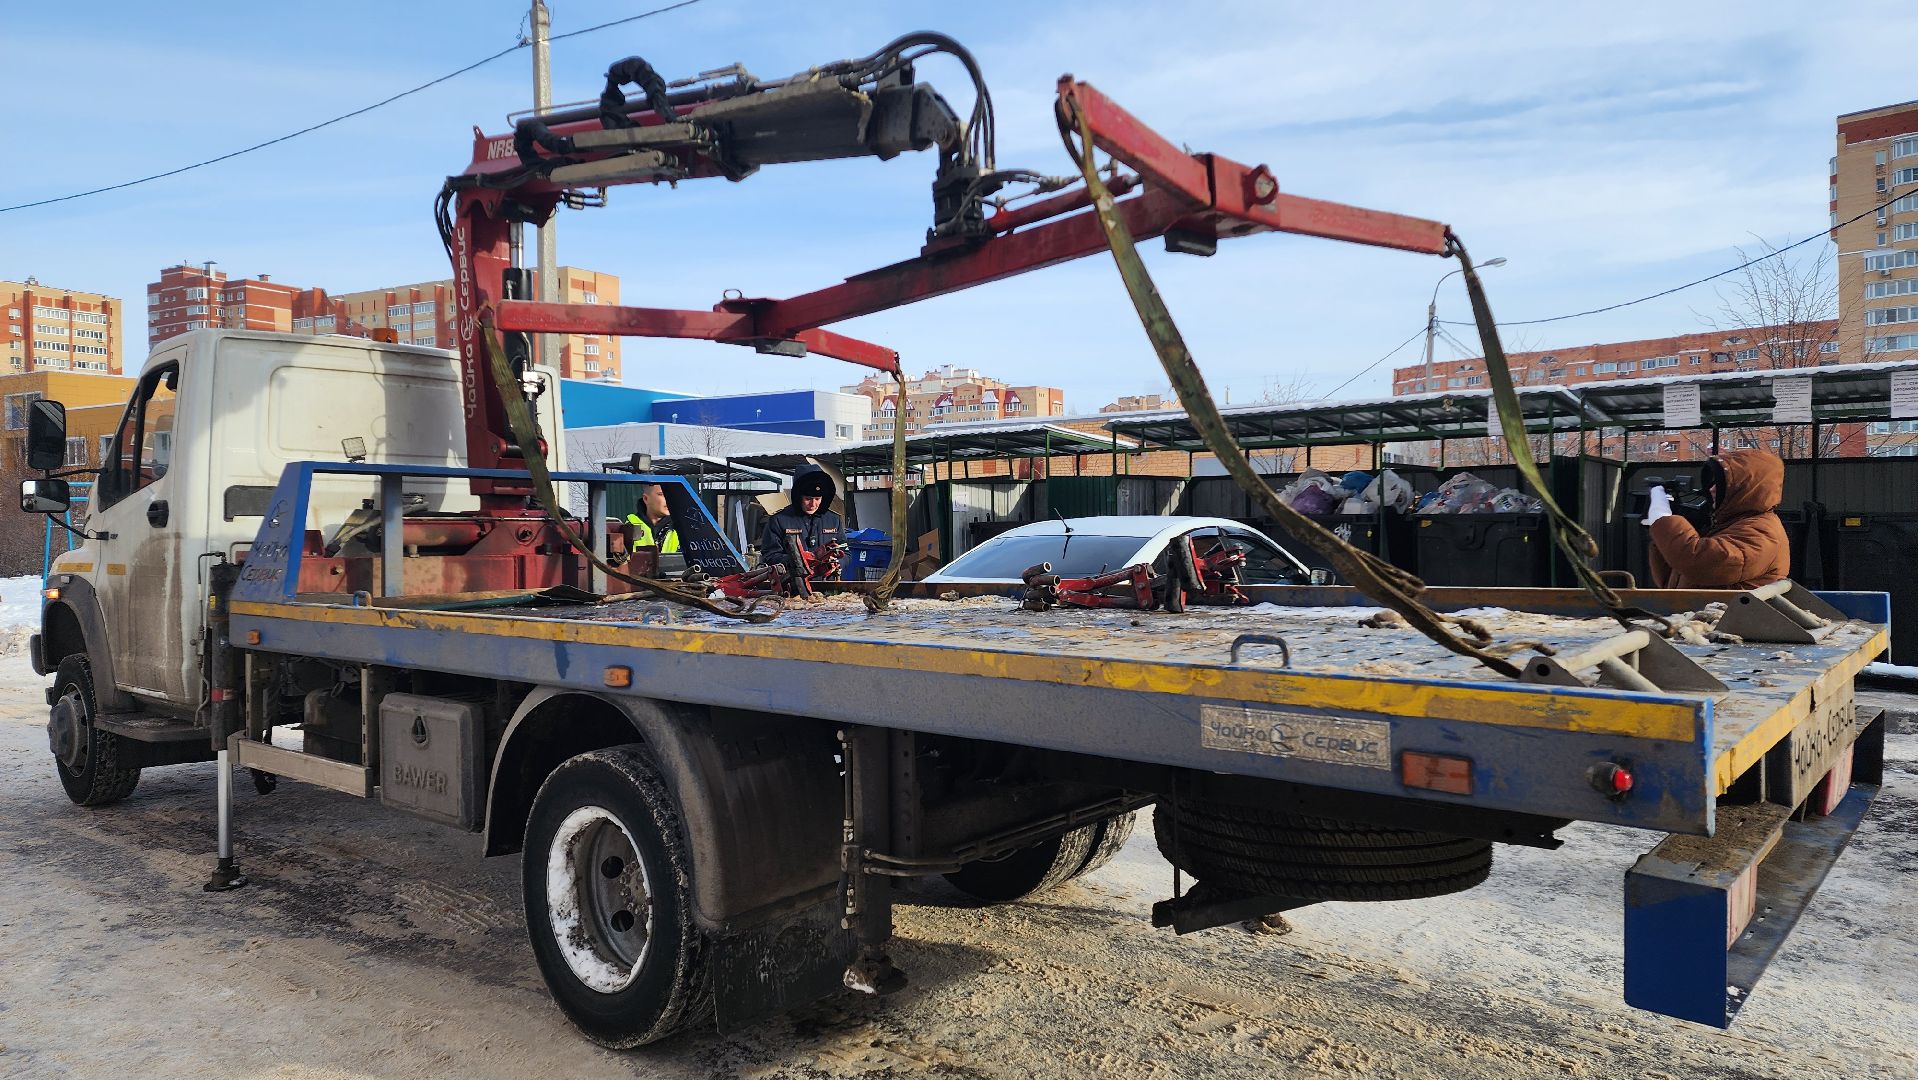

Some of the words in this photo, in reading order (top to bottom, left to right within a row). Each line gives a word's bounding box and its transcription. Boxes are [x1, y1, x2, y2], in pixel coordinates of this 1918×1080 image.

[487, 138, 518, 160] NR8
[465, 344, 477, 419] Чайка
[1211, 720, 1267, 741] Чайка
[1302, 731, 1378, 753] Сервис
[394, 762, 448, 795] BAWER
